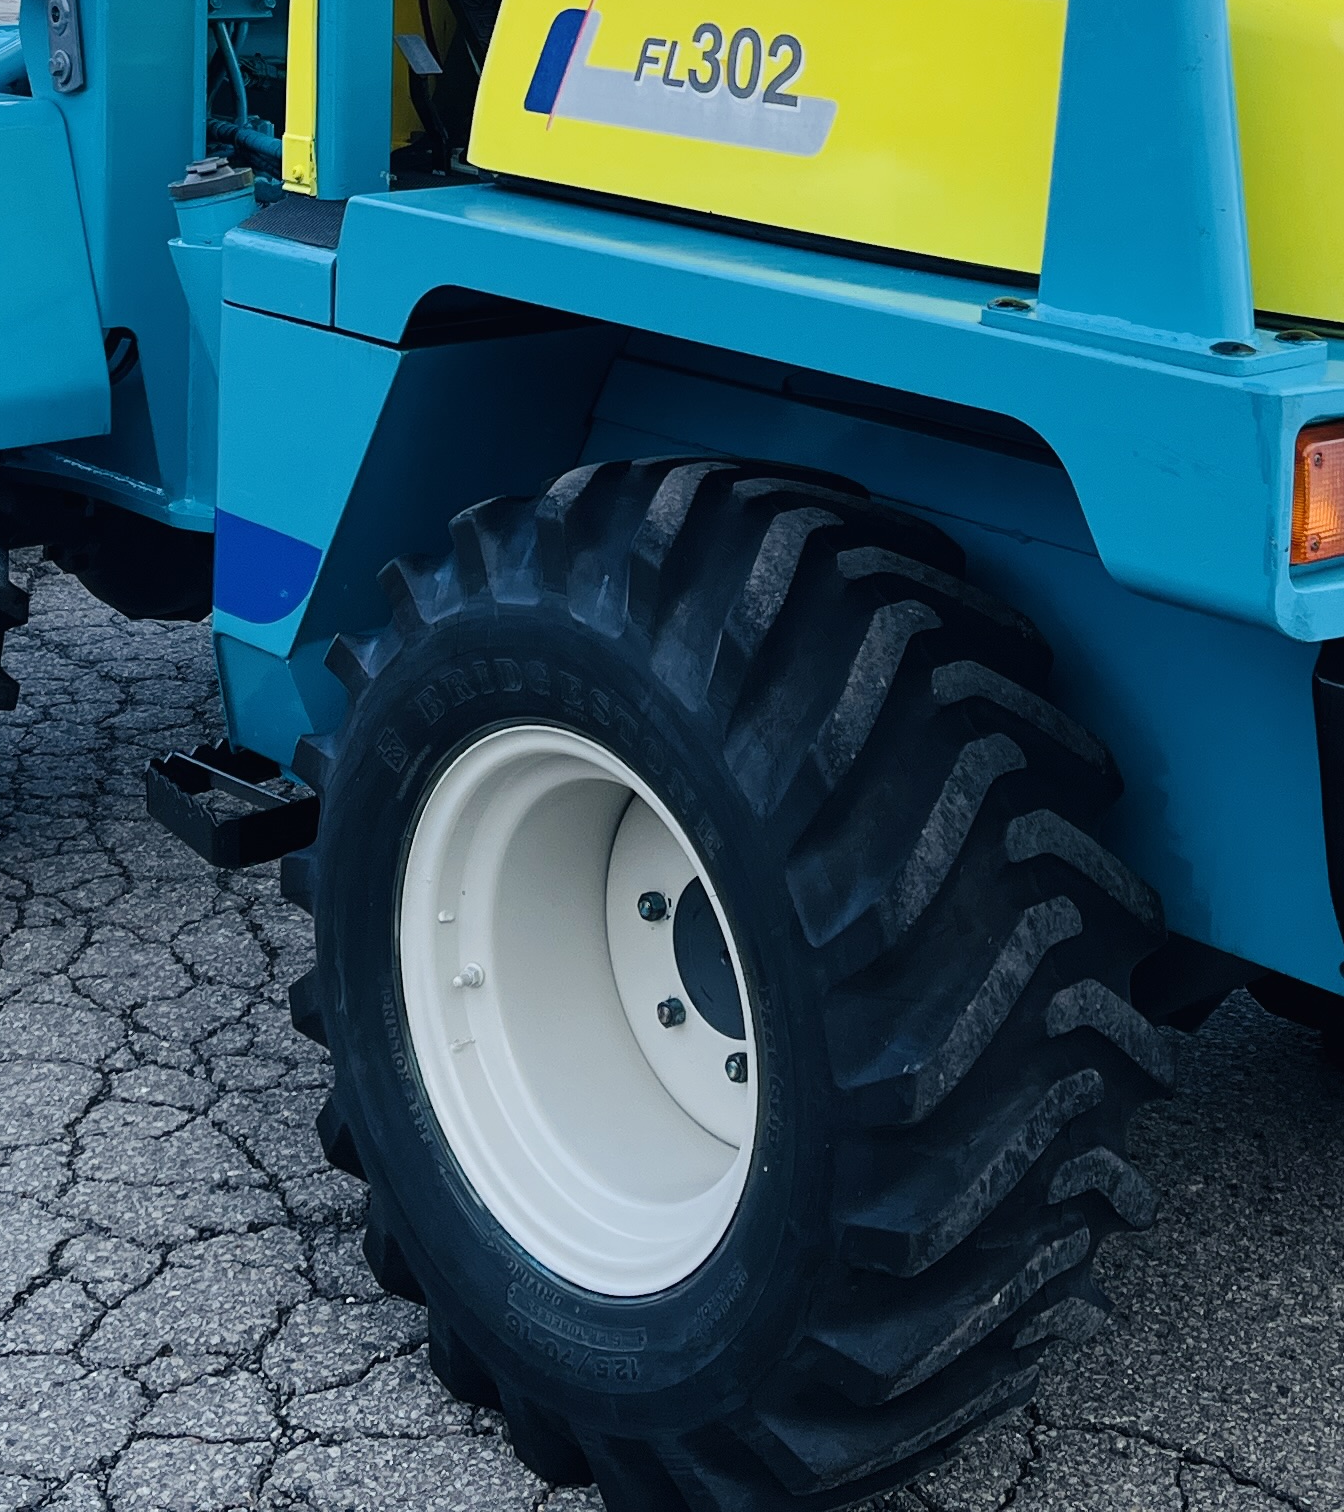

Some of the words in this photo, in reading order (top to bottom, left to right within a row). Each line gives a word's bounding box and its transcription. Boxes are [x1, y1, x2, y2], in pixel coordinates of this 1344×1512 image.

[633, 22, 803, 108] FL302
[414, 657, 725, 863] BRIDGESTONE
[505, 1259, 564, 1308] DRIVING
